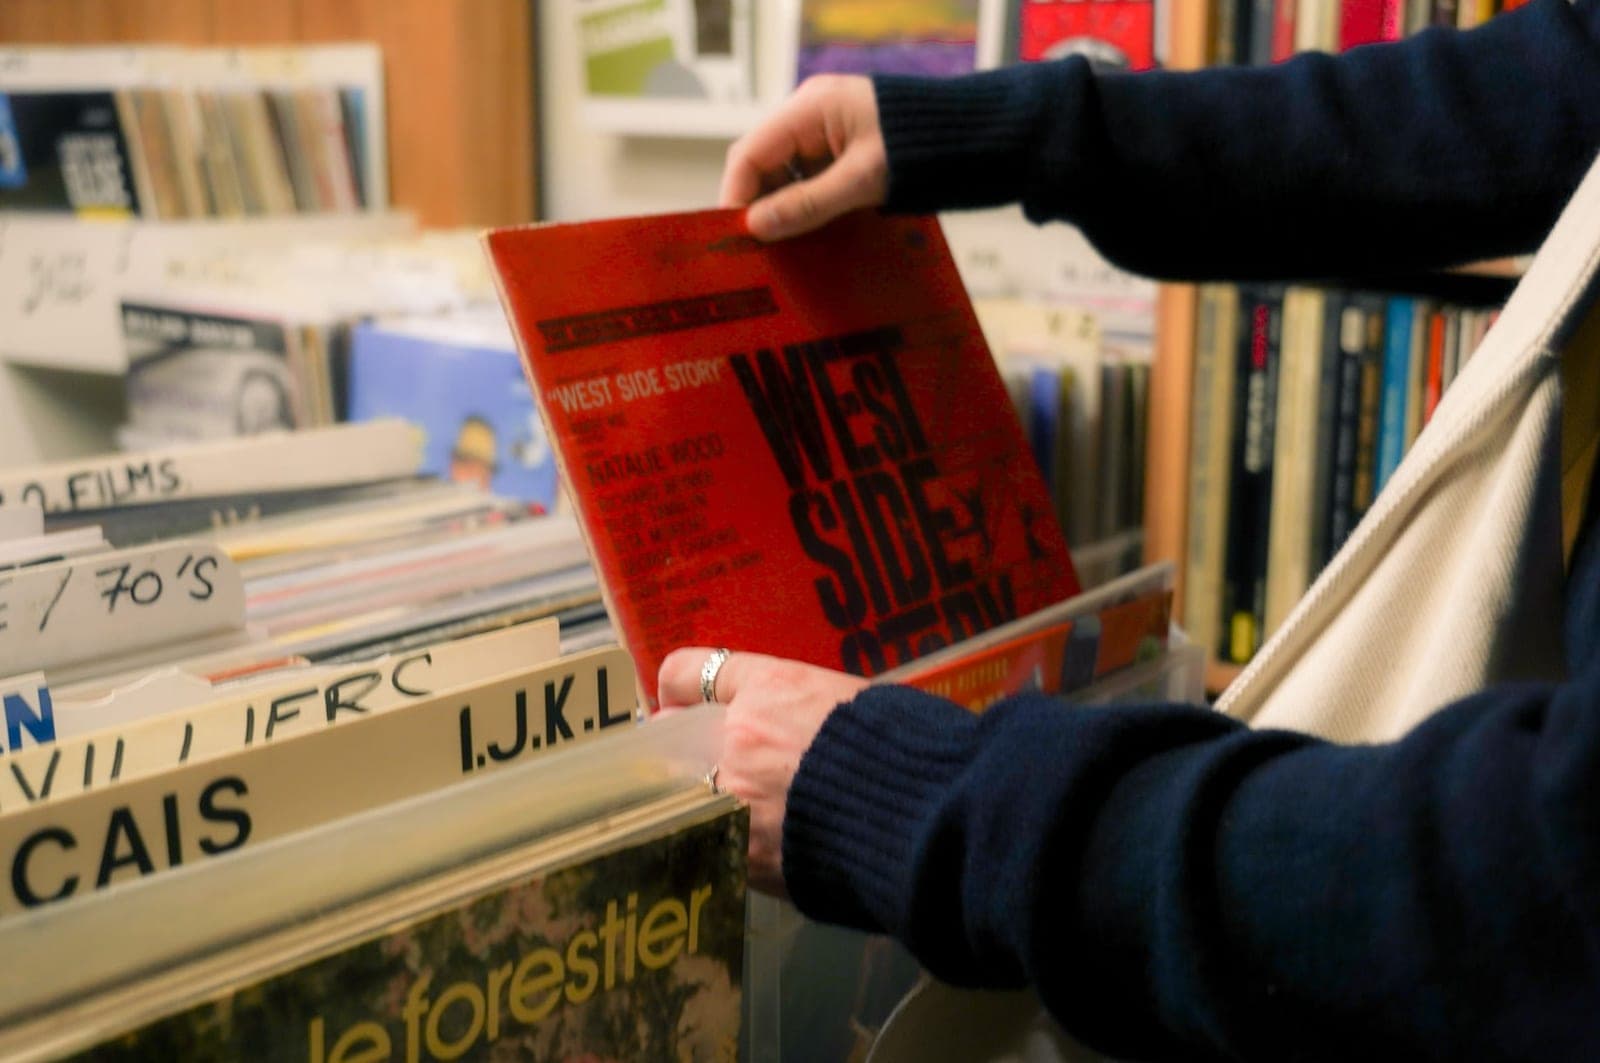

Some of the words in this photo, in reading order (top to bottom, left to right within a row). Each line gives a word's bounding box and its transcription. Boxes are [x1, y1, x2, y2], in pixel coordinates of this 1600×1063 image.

[616, 367, 665, 402] SIDE
[730, 322, 930, 492] WEST
[585, 445, 666, 487] NATALIE
[667, 431, 726, 465] WOOD
[95, 555, 219, 614] 70'S
[788, 457, 975, 630] SIDE
[11, 775, 254, 910] CAIS
[402, 884, 713, 1063] forestier
